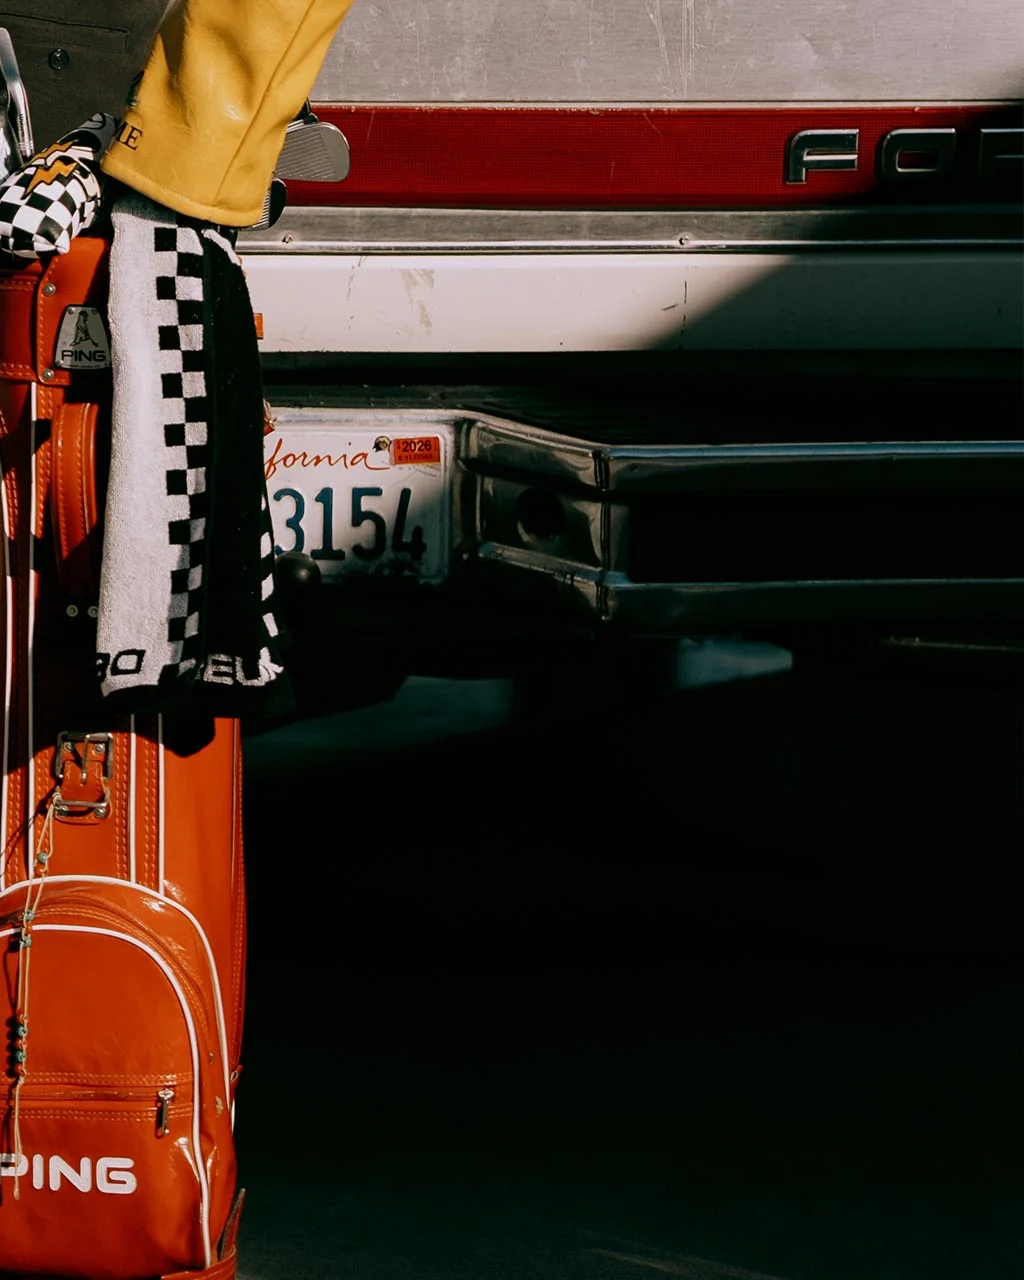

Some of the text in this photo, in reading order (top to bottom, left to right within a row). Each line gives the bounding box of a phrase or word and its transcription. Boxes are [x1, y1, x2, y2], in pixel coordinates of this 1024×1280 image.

[61, 350, 107, 362] PING
[402, 439, 432, 452] 2026
[264, 437, 390, 481] fornia
